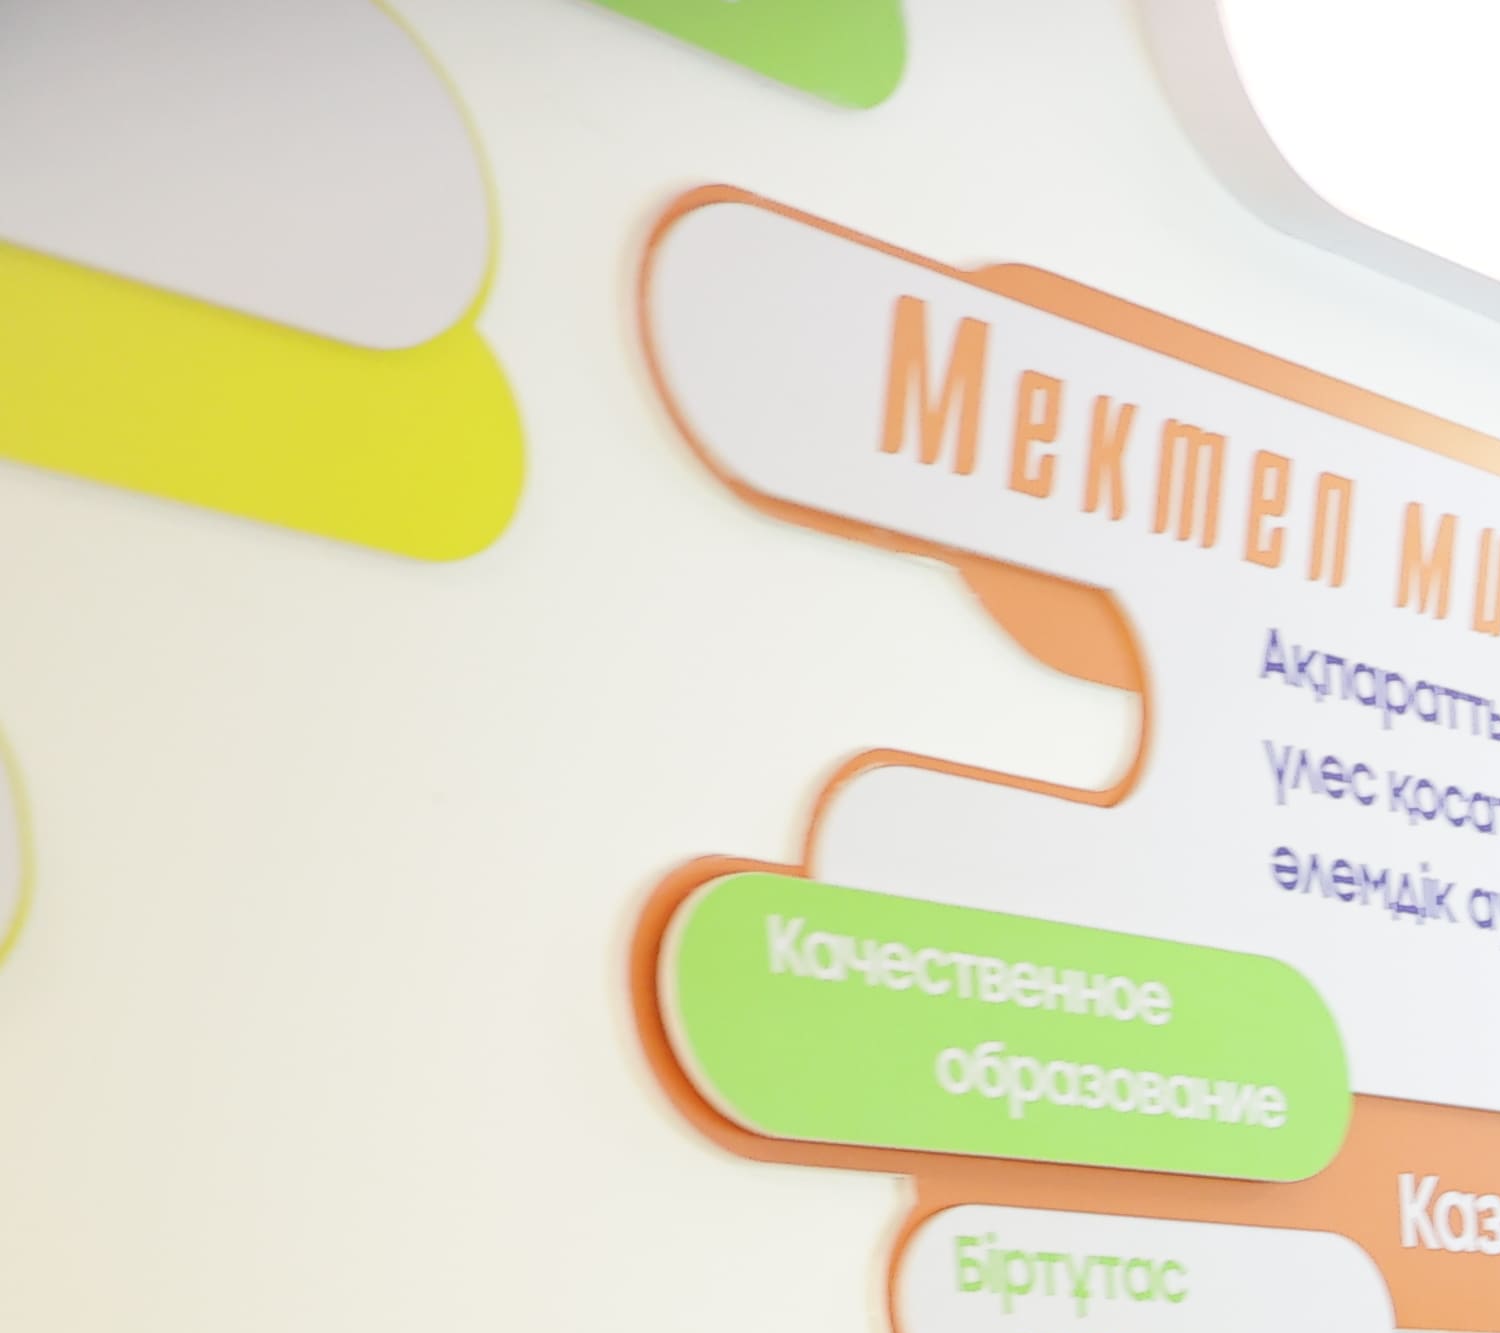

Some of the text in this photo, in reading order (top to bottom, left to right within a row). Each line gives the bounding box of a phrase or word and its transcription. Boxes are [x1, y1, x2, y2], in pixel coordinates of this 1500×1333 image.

[880, 294, 1354, 588] Мектеп
[1262, 739, 1377, 806] үлес
[1269, 846, 1459, 925] әлемдік
[764, 913, 1174, 1026] Качественное
[935, 1041, 1288, 1130] образование
[953, 1233, 1190, 1319] Біртұтас
